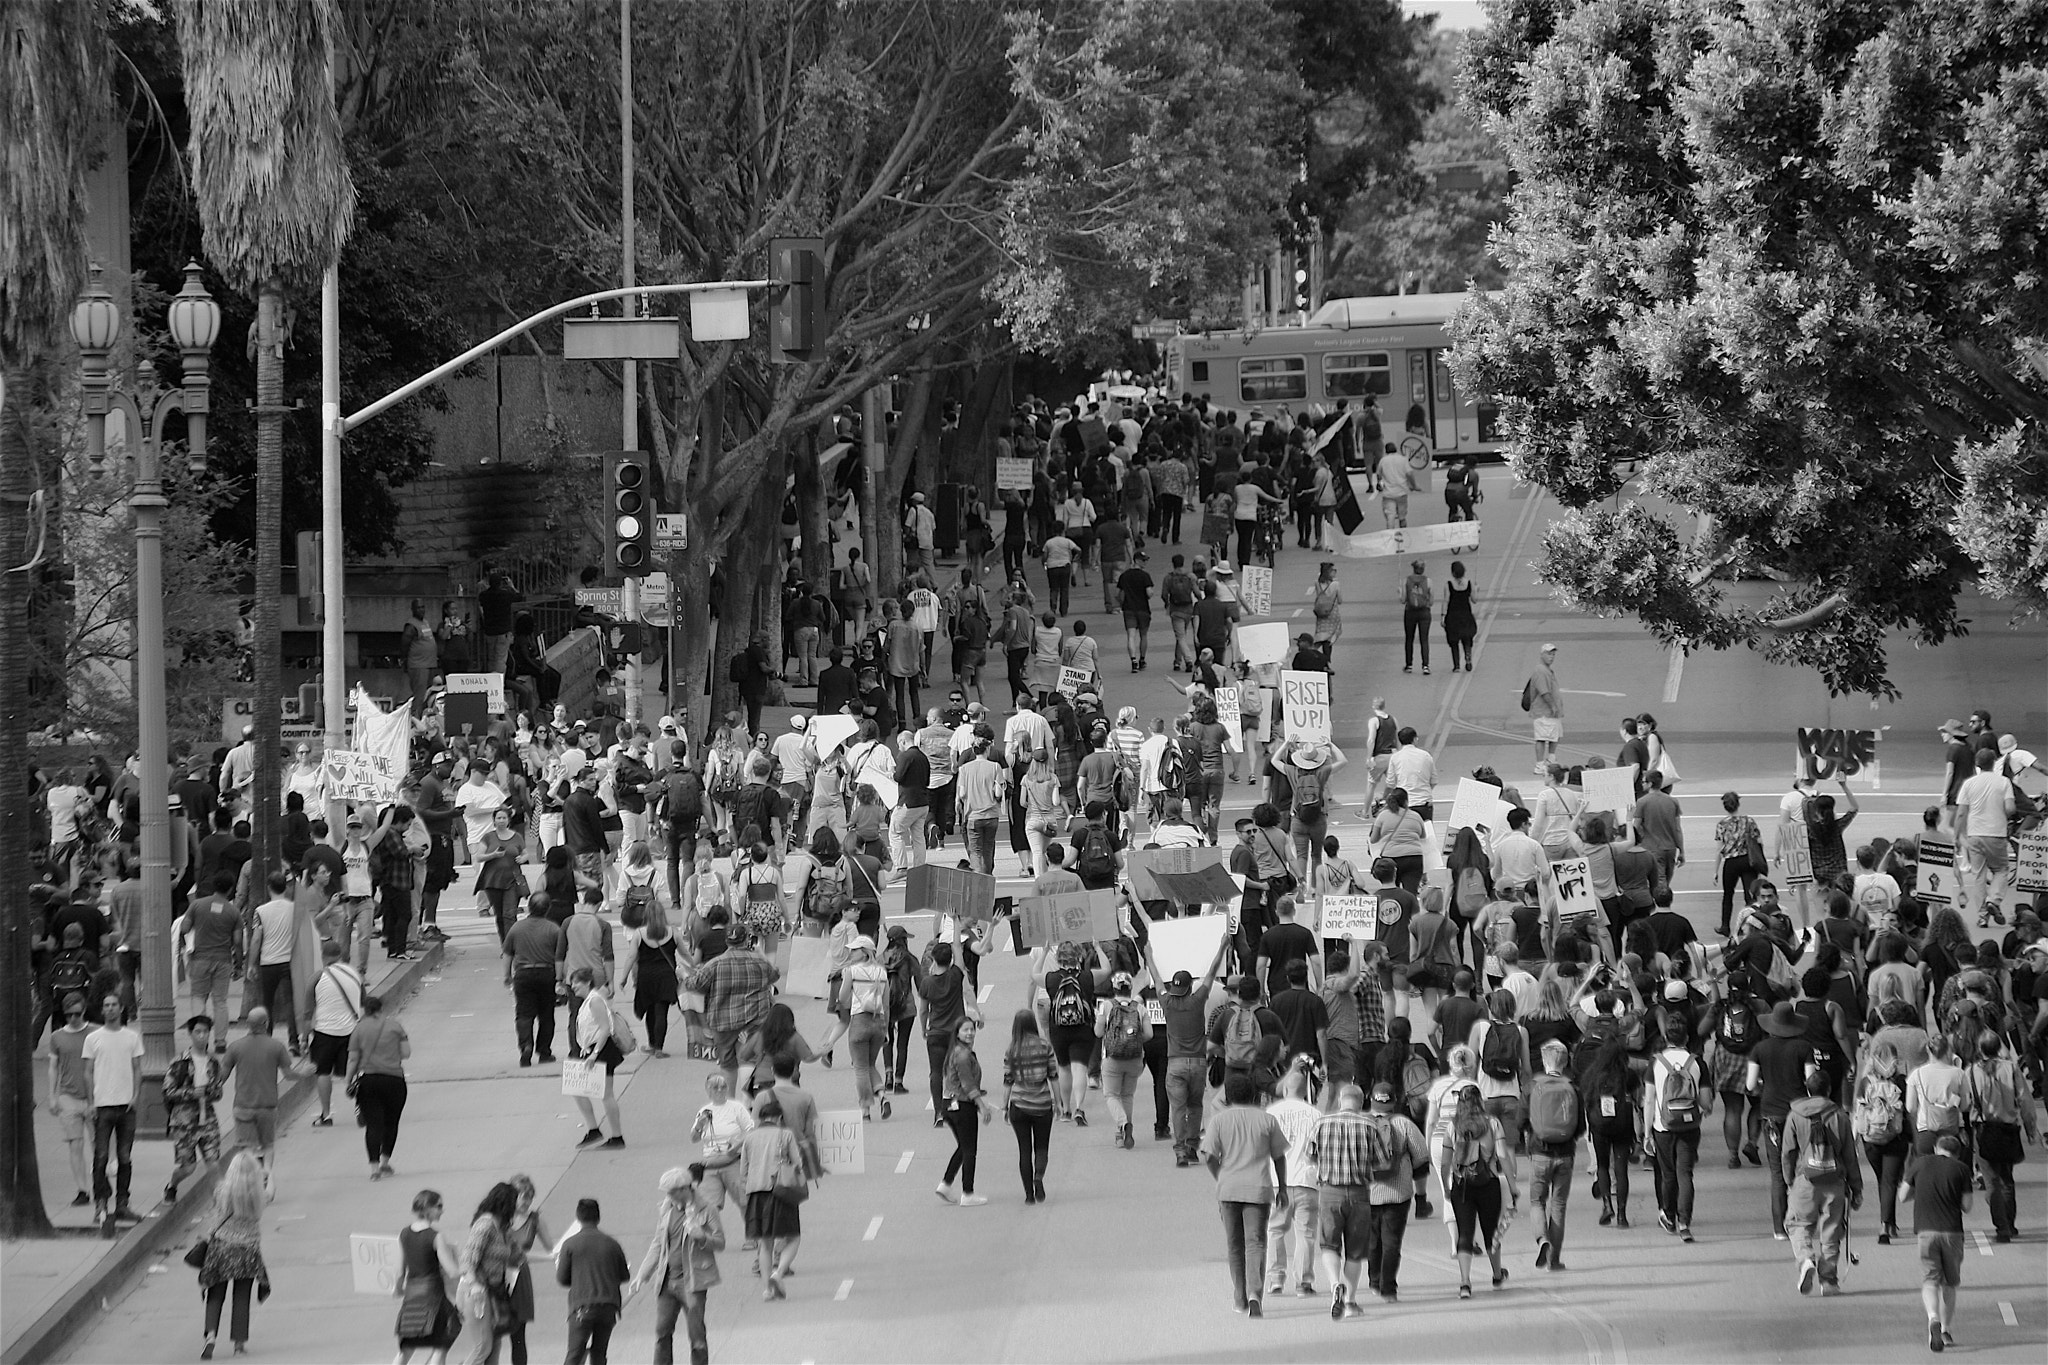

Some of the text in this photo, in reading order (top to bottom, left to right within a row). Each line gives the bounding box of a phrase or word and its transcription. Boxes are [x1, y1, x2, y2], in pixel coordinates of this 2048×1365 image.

[577, 590, 620, 603] Spring St
[614, 604, 620, 612] N
[1065, 670, 1086, 681] STAND
[1216, 688, 1237, 702] NO
[1285, 680, 1328, 706] RISE
[1218, 701, 1239, 712] MORE
[1219, 711, 1240, 722] HATE
[1292, 709, 1324, 729] UP!
[281, 730, 311, 738] COUNTY
[1798, 727, 1876, 766] WAKE
[371, 755, 394, 776] HATE
[1806, 754, 1861, 780] UP
[350, 767, 375, 784] WILL
[331, 781, 360, 799] LIGHT
[1779, 823, 1810, 850] WAKE
[1787, 851, 1811, 875] UP!
[1558, 876, 1588, 901] UP!
[1325, 897, 1338, 907] We
[1339, 897, 1358, 907] must
[1328, 906, 1376, 921] and protect
[1325, 918, 1375, 930] one another
[832, 1122, 861, 1141] NOT
[358, 1241, 392, 1267] ONE
